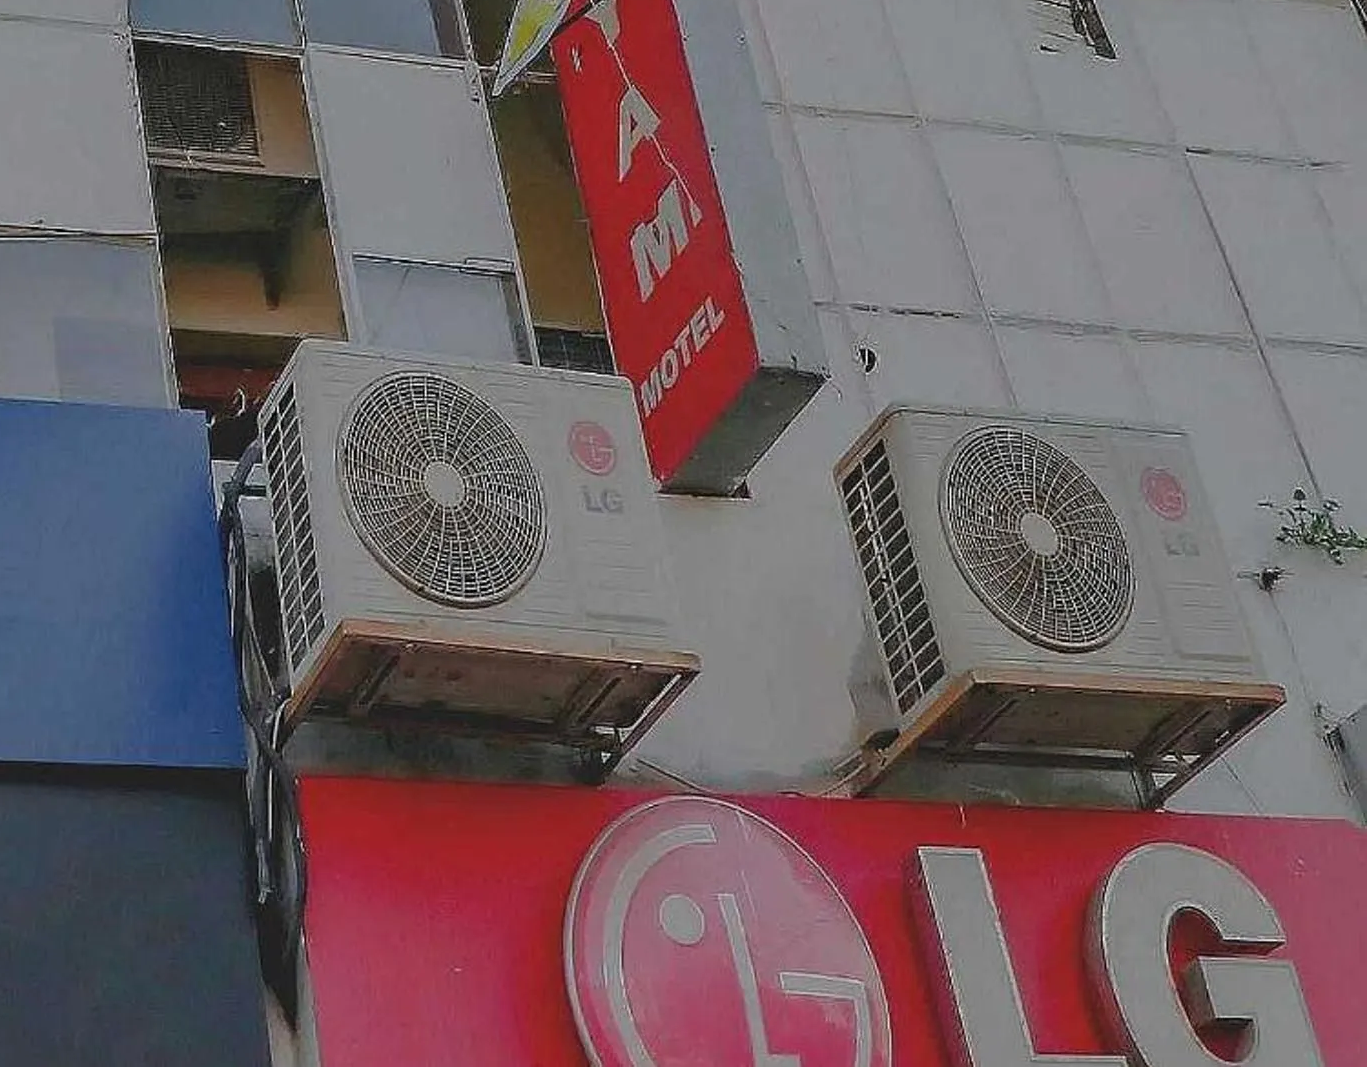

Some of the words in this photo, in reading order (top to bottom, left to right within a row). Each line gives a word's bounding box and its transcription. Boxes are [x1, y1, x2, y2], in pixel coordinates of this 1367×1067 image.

[640, 295, 726, 419] MOTEL
[581, 486, 624, 514] LG
[1163, 531, 1201, 557] LG
[917, 842, 1325, 1067] LG
